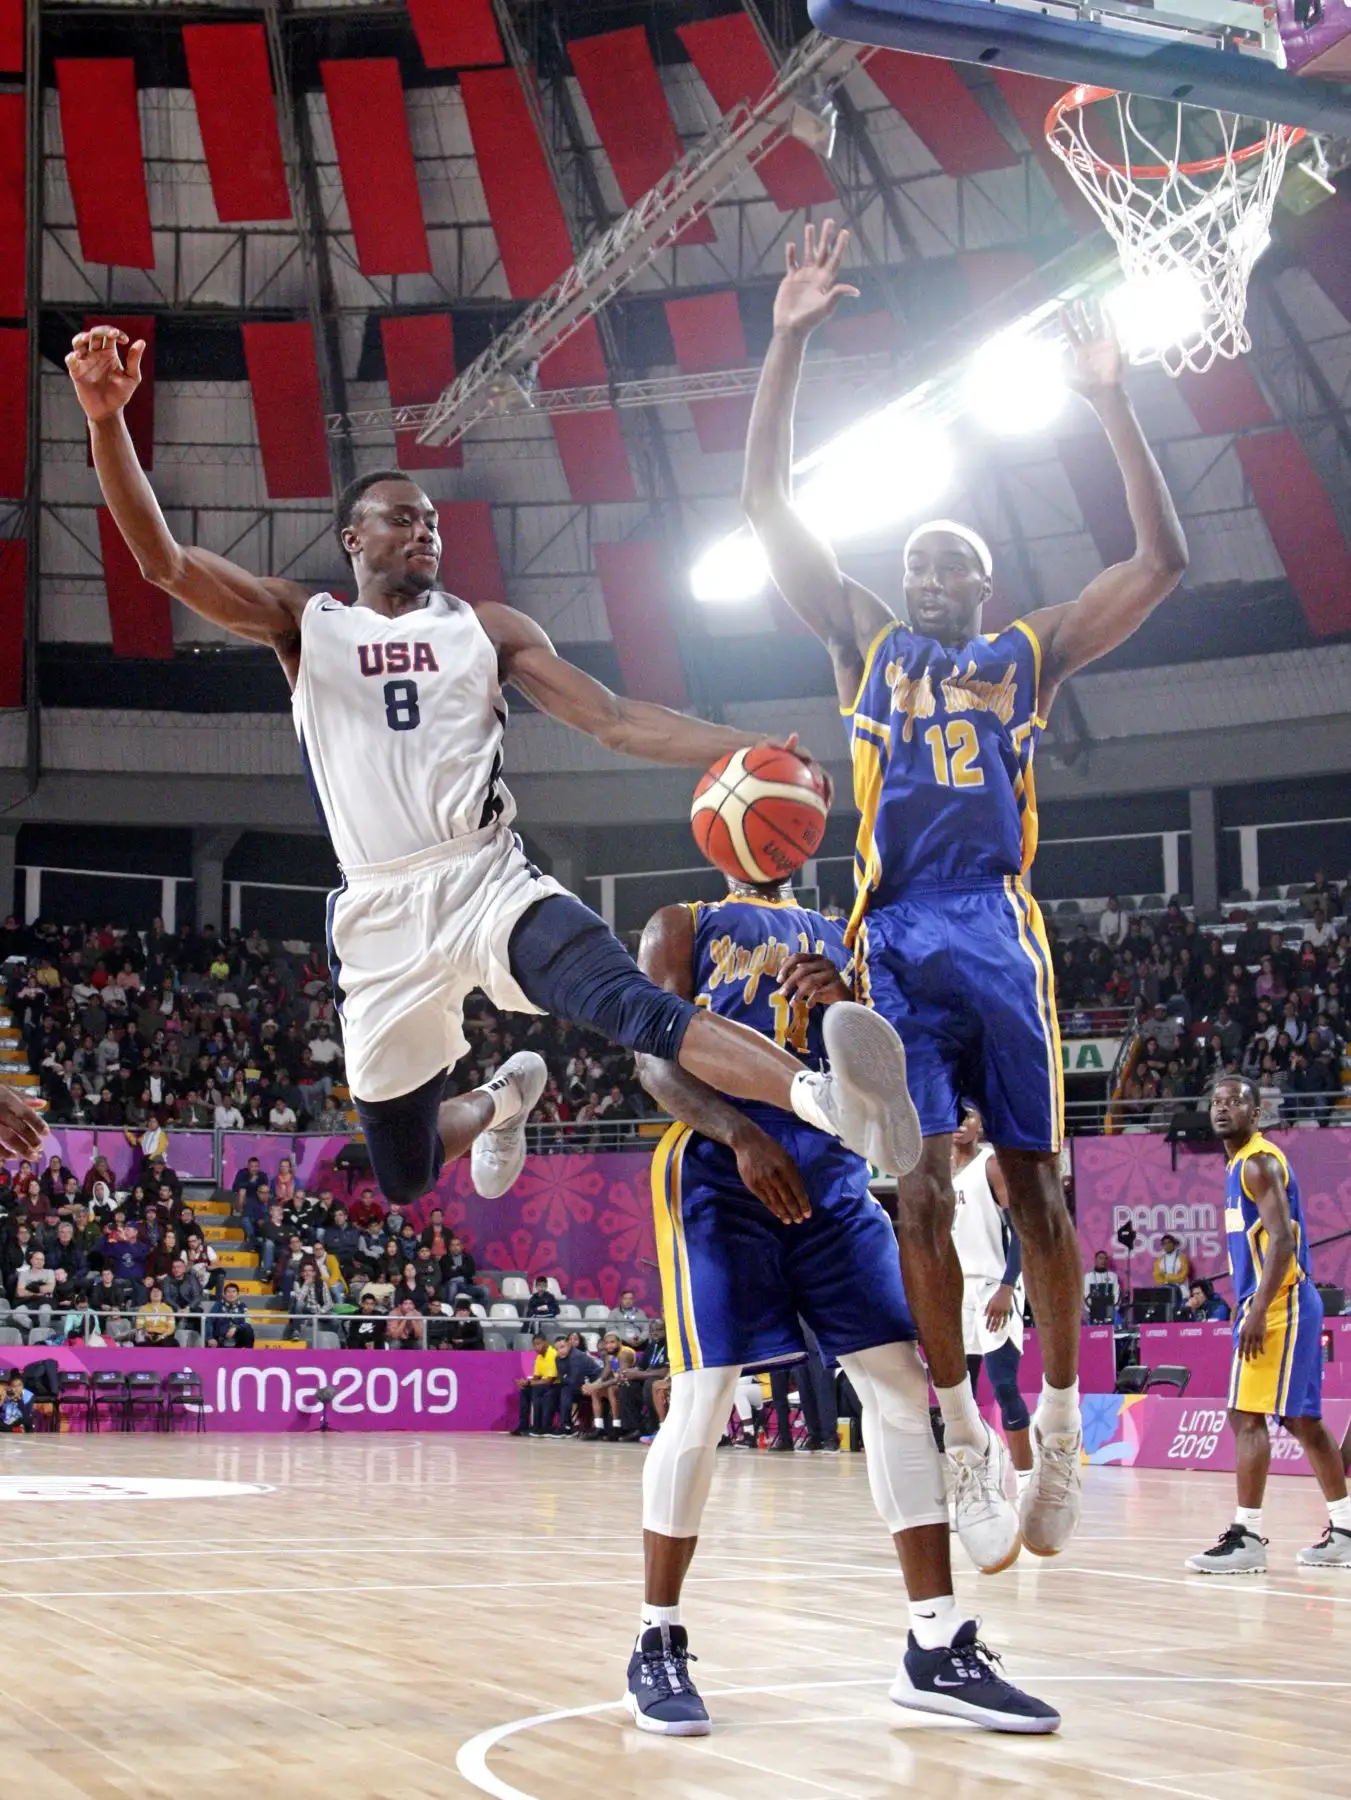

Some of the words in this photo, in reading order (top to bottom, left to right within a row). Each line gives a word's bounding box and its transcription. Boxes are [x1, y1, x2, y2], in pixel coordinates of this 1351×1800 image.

[357, 641, 439, 677] USA
[383, 678, 421, 732] 8
[924, 718, 985, 788] 12
[708, 934, 790, 1005] Virgin
[1113, 1203, 1217, 1232] PANAM
[1167, 1434, 1219, 1460] 2019
